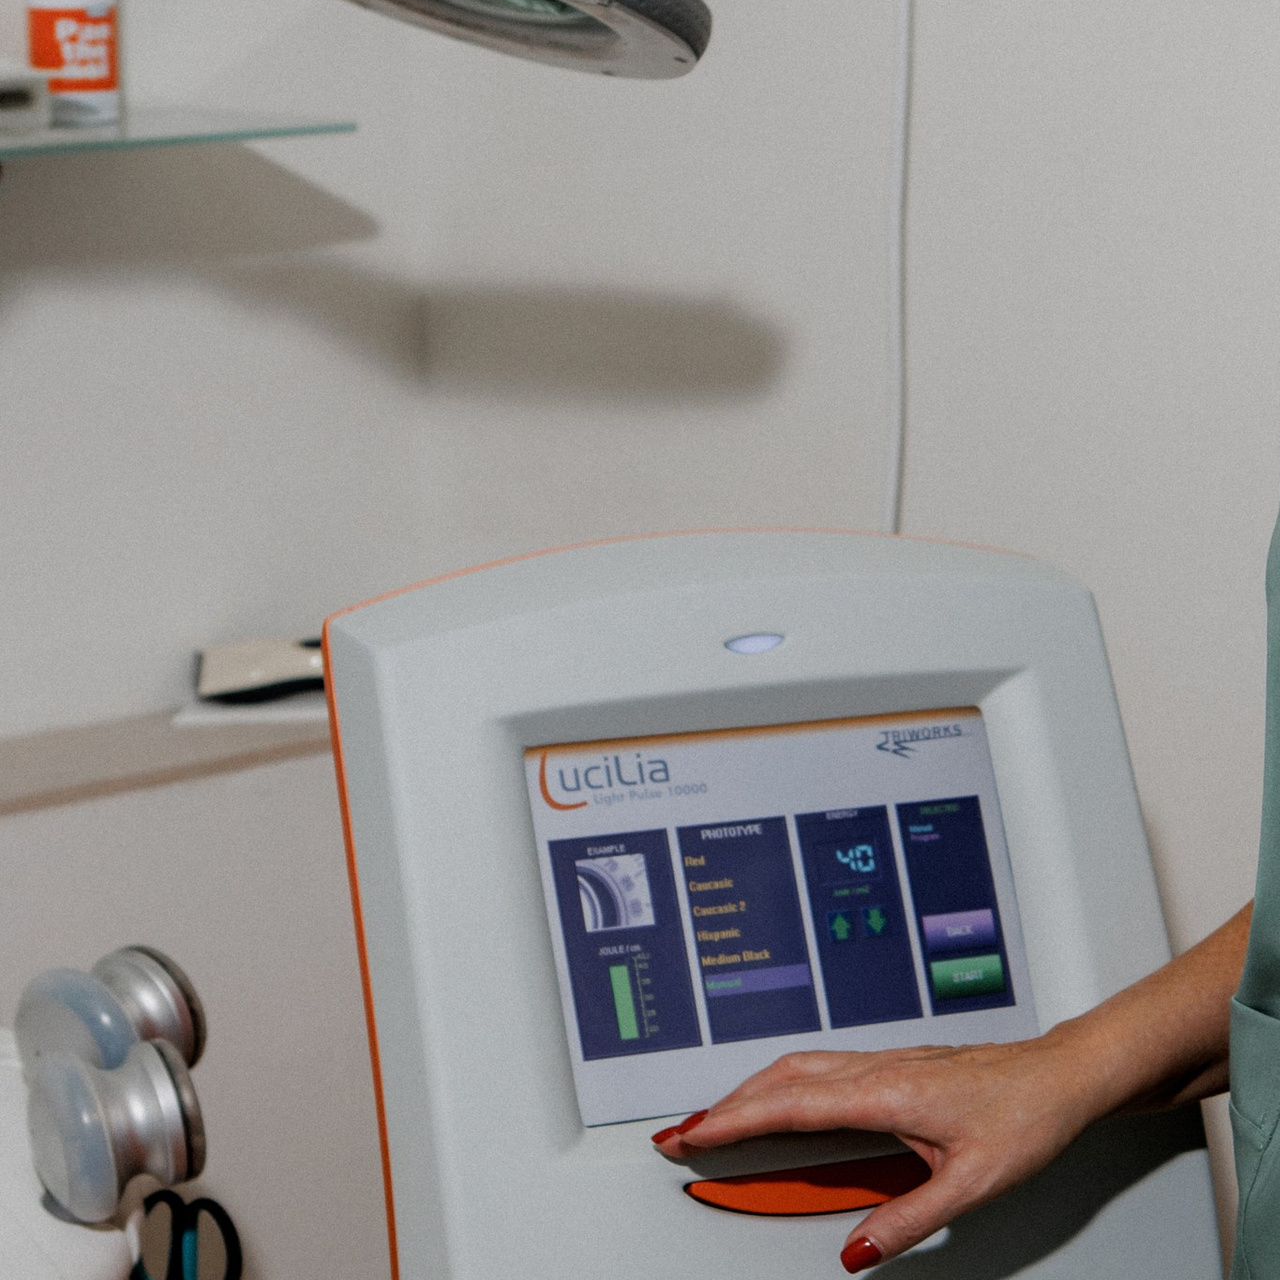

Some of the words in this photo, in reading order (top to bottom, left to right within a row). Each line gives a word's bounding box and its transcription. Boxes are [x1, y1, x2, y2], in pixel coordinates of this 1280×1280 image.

[539, 751, 670, 811] LuciLia
[594, 790, 625, 805] Light
[629, 788, 662, 801] Pulse
[701, 823, 762, 840] PHOTOTYPE
[586, 843, 626, 856] EXAMPLE
[835, 844, 876, 872] 40
[684, 855, 705, 866] Red
[689, 877, 734, 891] Caucasic
[693, 902, 737, 917] Caucasic
[739, 900, 746, 911] 2
[697, 928, 741, 942] Hispanic
[701, 952, 741, 966] Medium
[742, 949, 771, 962] Black
